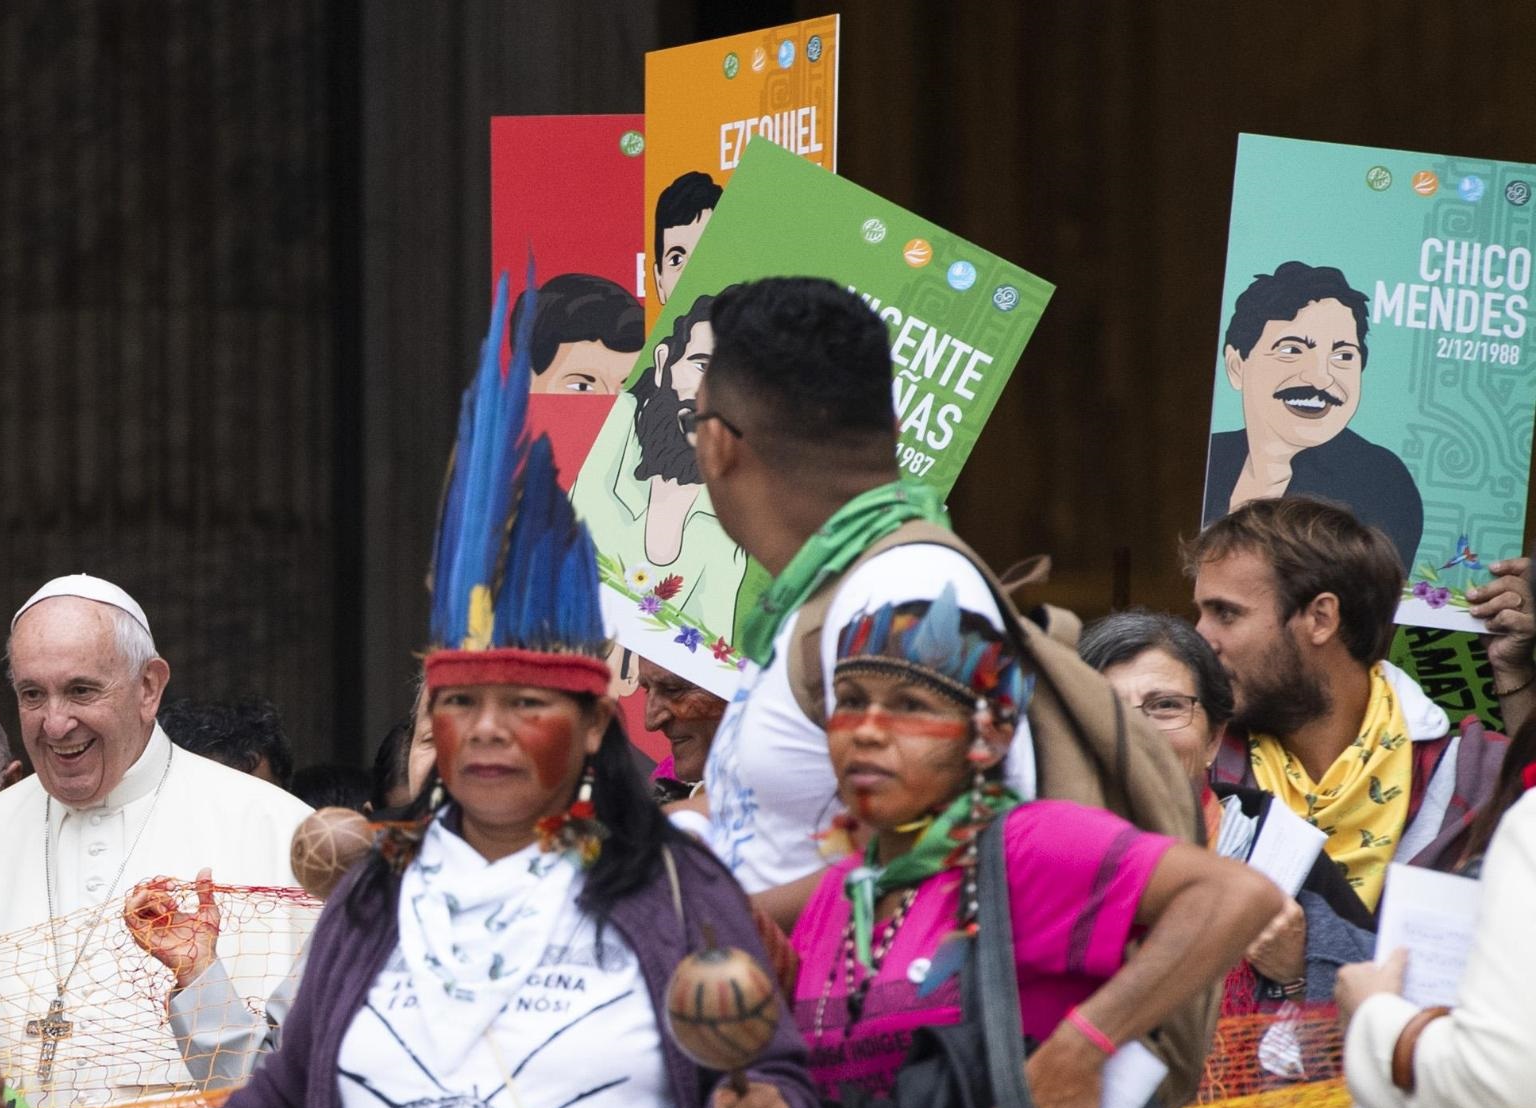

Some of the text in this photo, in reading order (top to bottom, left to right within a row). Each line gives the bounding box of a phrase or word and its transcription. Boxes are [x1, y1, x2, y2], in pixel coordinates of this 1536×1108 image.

[1419, 237, 1532, 291] CHICO
[1372, 280, 1528, 339] MENDES
[848, 285, 994, 401] ENTE
[1436, 337, 1520, 366] 2/12/1988
[892, 369, 963, 450] ÑAS
[895, 442, 936, 478] 1987
